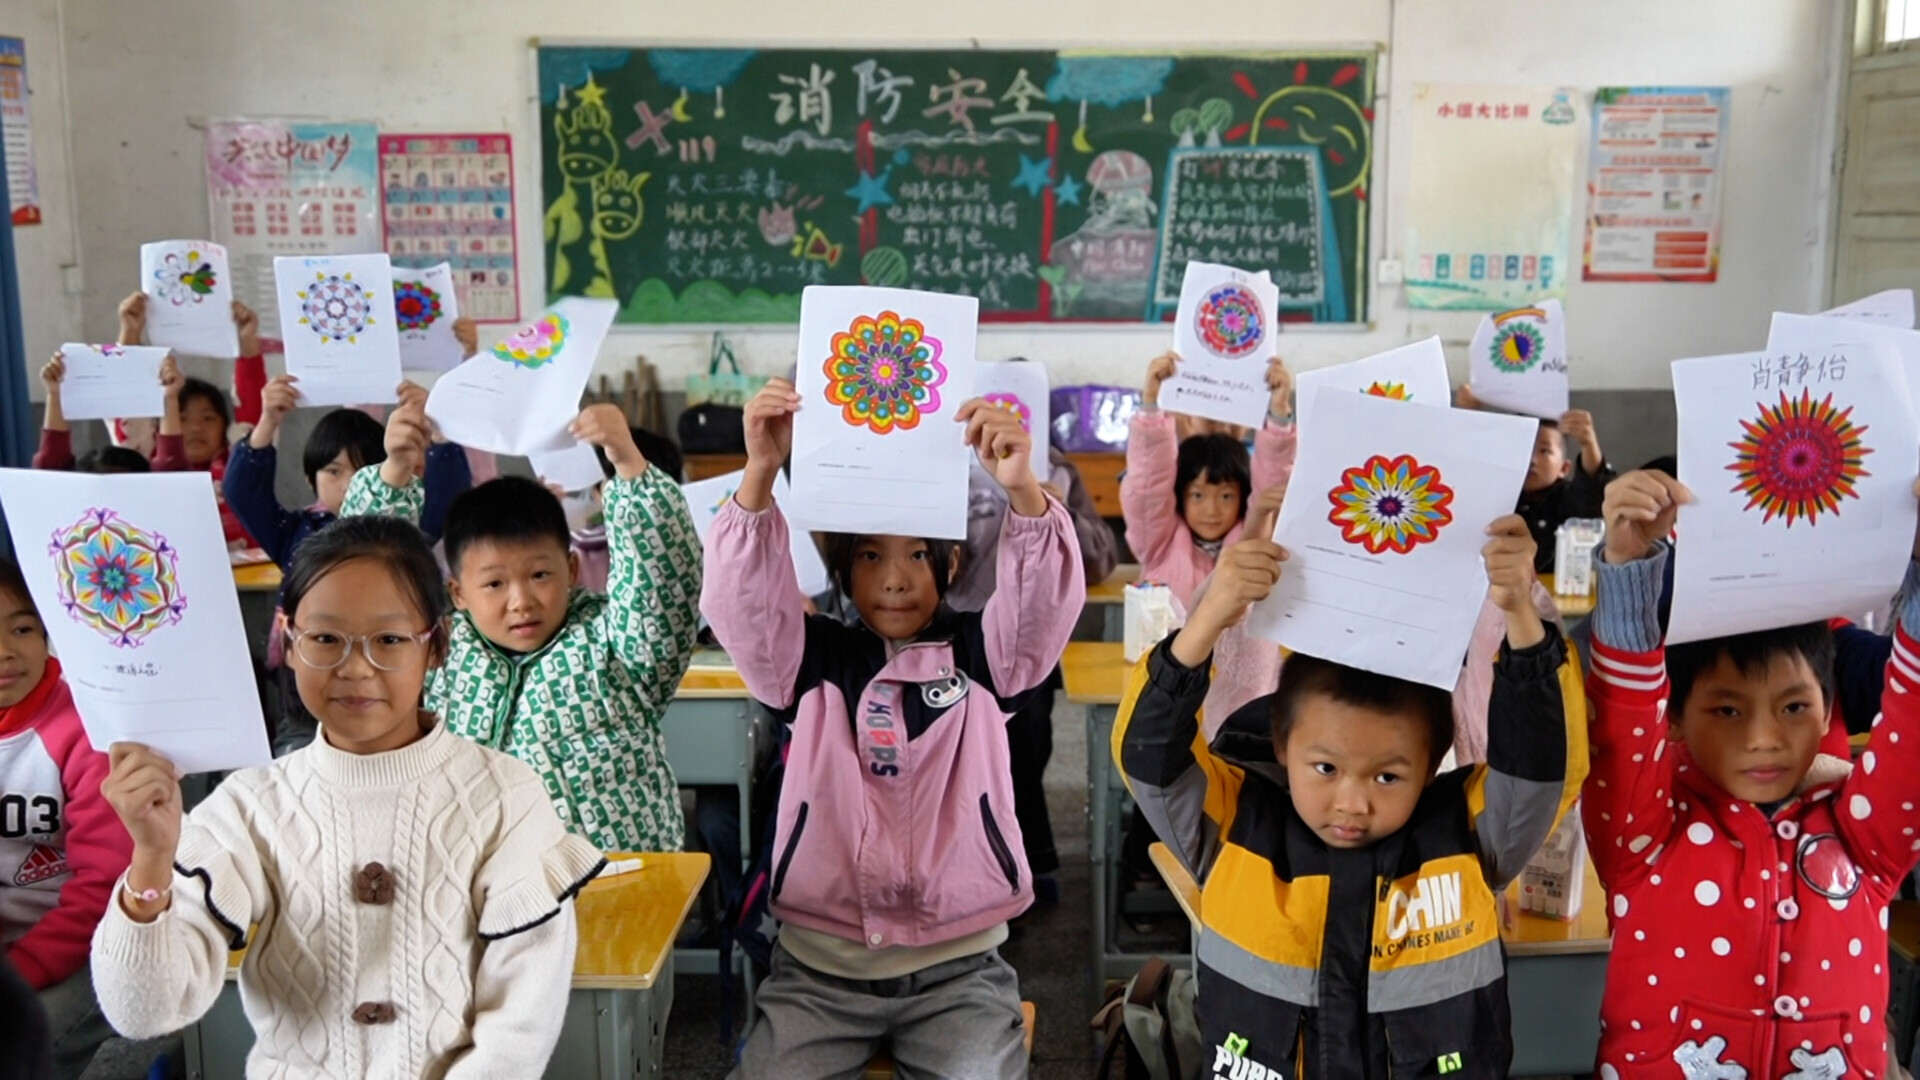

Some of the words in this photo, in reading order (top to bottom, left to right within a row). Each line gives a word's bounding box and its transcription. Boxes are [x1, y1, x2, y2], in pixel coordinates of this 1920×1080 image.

[769, 58, 1055, 136] 消防安全
[678, 135, 717, 163] 119
[867, 702, 898, 776] HOPPS
[0, 794, 60, 838] 03
[1387, 872, 1462, 940] CHIN
